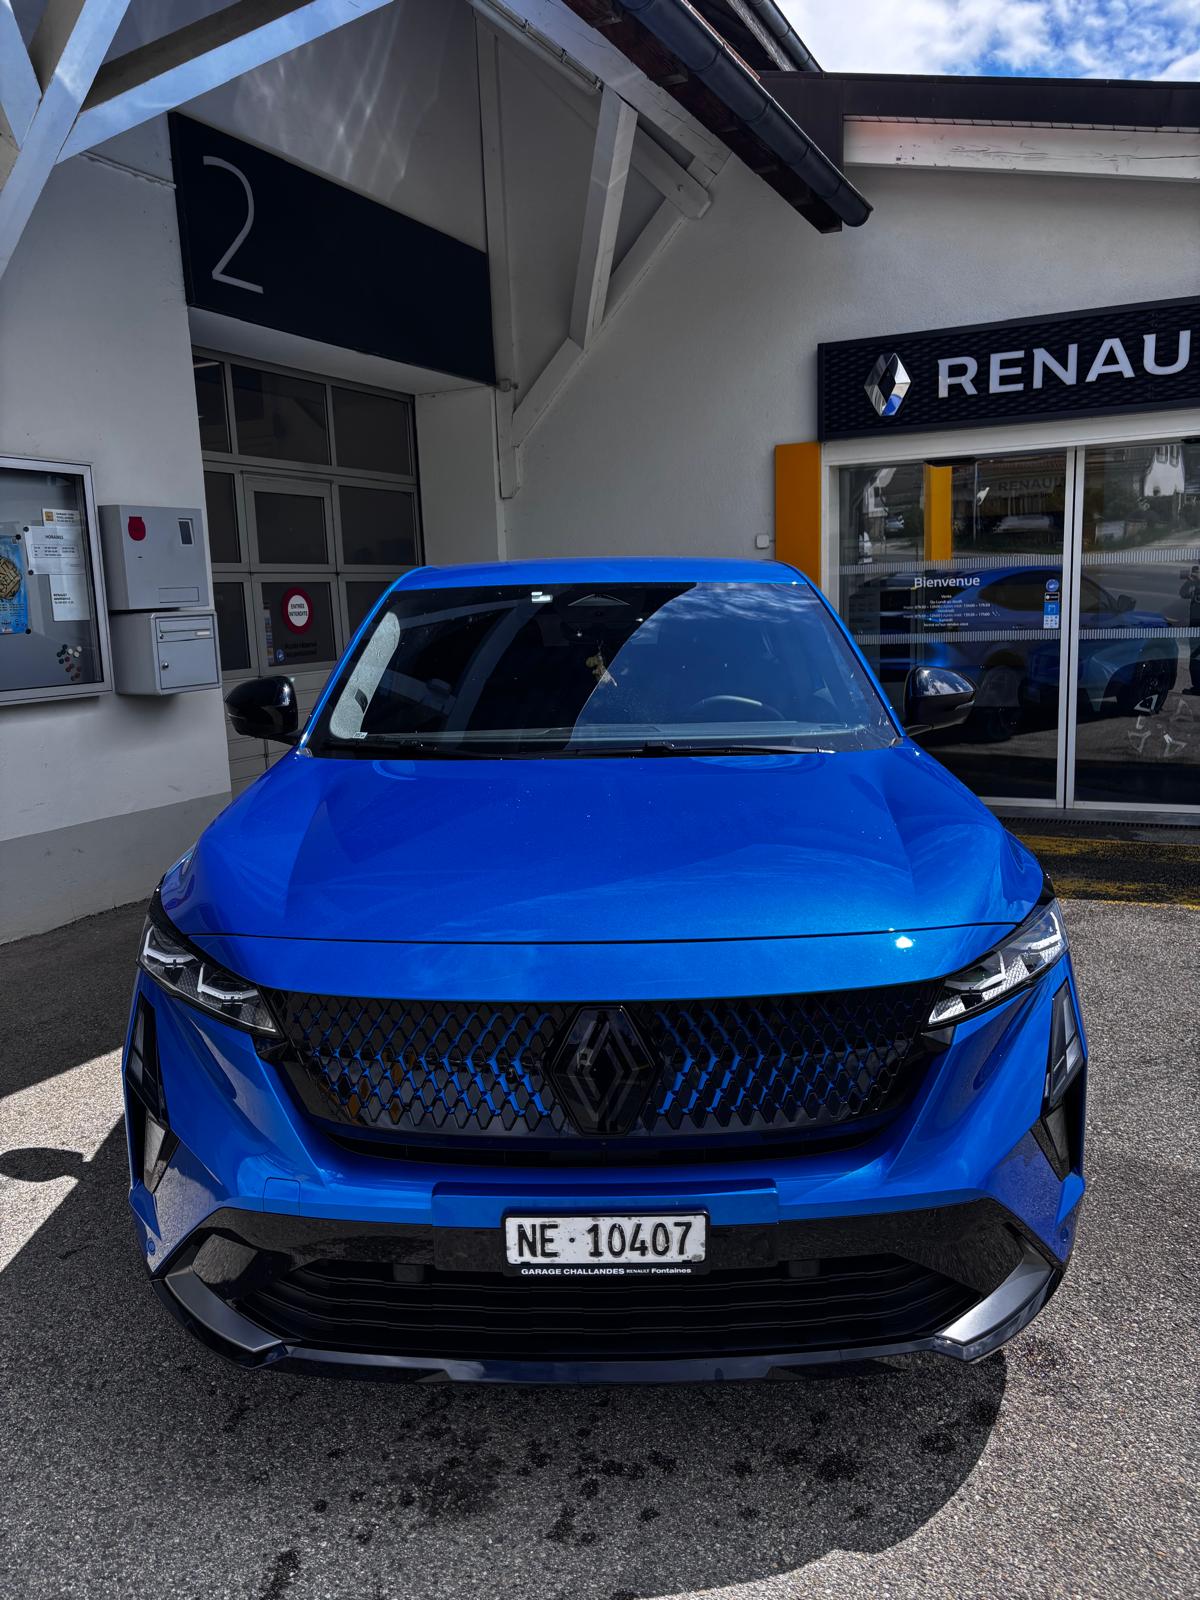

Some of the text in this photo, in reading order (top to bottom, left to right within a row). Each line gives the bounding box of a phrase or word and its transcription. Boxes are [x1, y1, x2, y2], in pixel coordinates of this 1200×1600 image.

[203, 156, 264, 294] 2
[937, 329, 1192, 399] RENAU
[914, 576, 980, 588] Bienvenue
[517, 1221, 693, 1258] NE 10407
